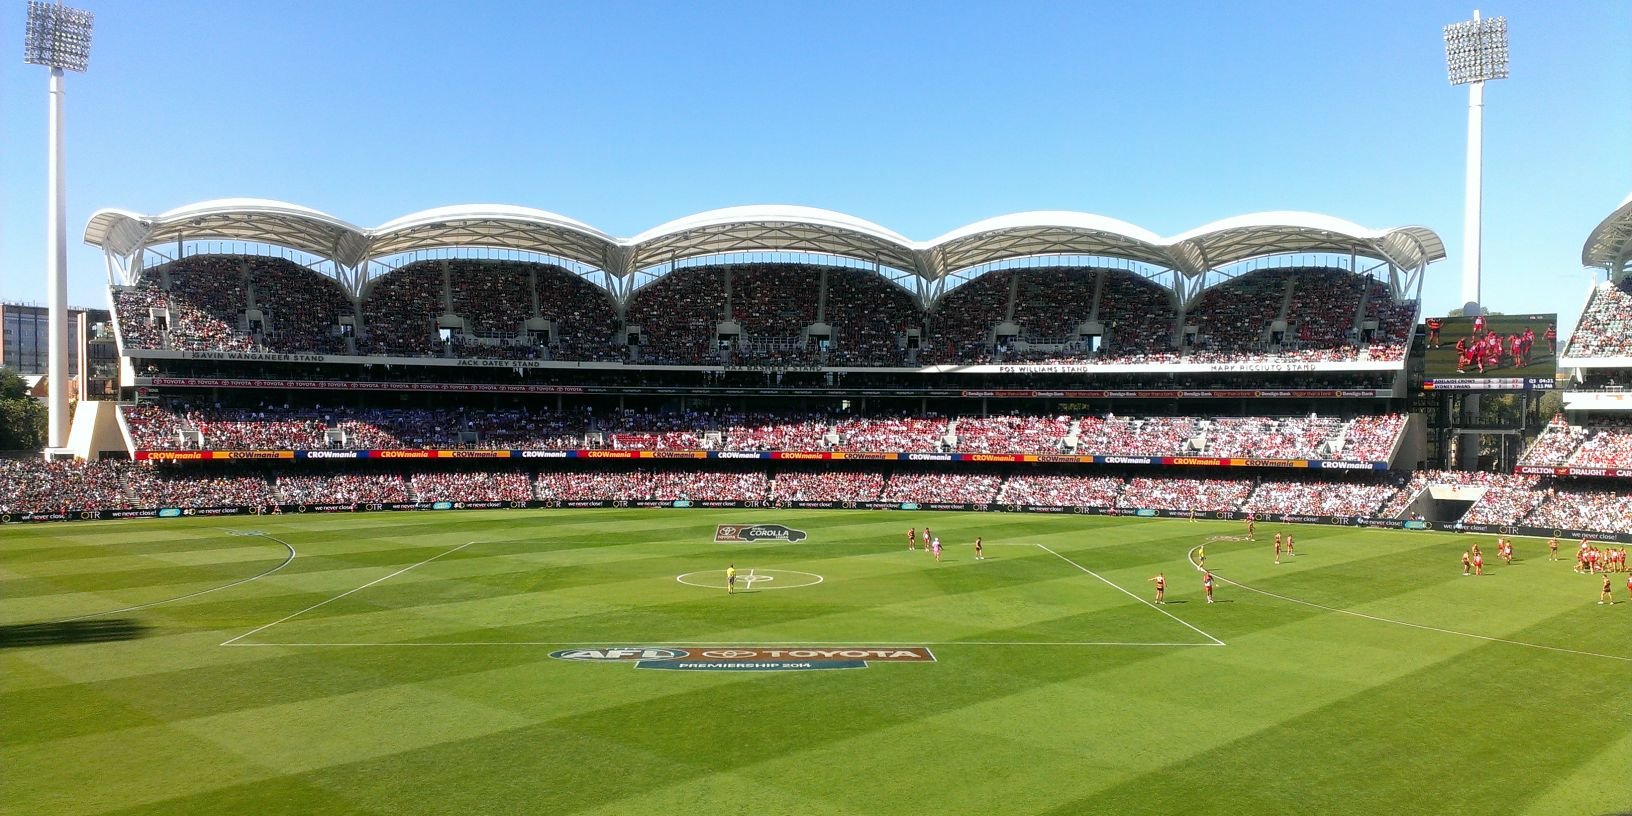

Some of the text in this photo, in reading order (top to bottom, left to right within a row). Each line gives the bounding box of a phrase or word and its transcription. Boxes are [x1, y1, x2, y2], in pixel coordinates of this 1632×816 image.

[192, 351, 325, 362] GAVIN WANGANEEN STAND
[457, 359, 479, 367] JACK
[512, 360, 540, 368] STAND
[147, 451, 202, 460] CROWmania
[228, 451, 280, 459] CROWmania
[781, 452, 823, 460] CROWmania
[1037, 455, 1081, 463] CROWmania
[1105, 457, 1151, 465] CROWmania
[1174, 458, 1221, 466] CROWmania
[1245, 459, 1294, 468] CROWmania
[1321, 461, 1374, 470] CROWmania
[1569, 468, 1607, 476] DRAUGHT
[81, 512, 101, 520] OTR
[1217, 512, 1234, 520] OTR
[1331, 517, 1350, 525] OTR
[1499, 526, 1519, 534] OTR
[561, 649, 923, 659] AFL TOYOTA
